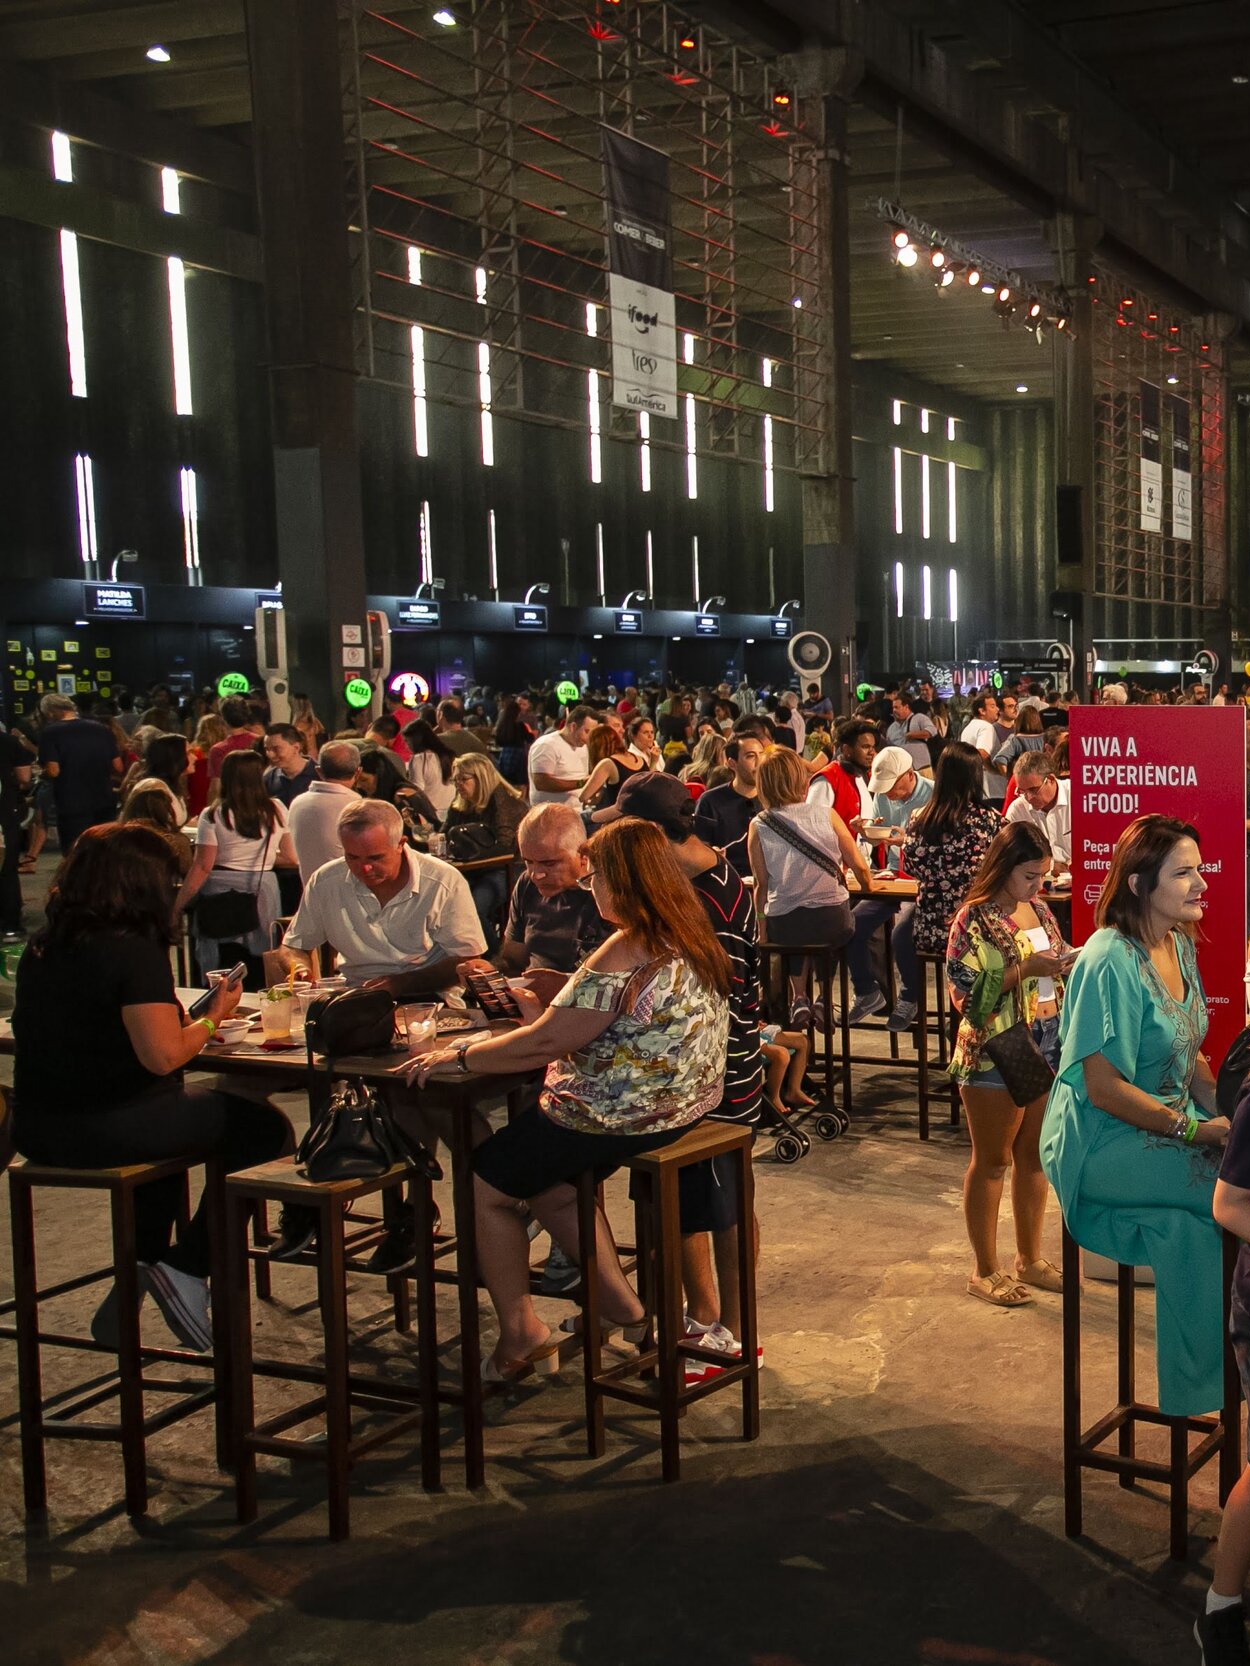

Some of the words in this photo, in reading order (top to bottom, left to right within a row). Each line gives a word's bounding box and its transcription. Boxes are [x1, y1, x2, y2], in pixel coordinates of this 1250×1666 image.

[222, 678, 246, 691] CAIXA
[1081, 737, 1121, 757] VIVA
[1126, 737, 1138, 757] A
[1082, 762, 1198, 786] EXPERIÊNCIA
[1083, 839, 1110, 855] Peça
